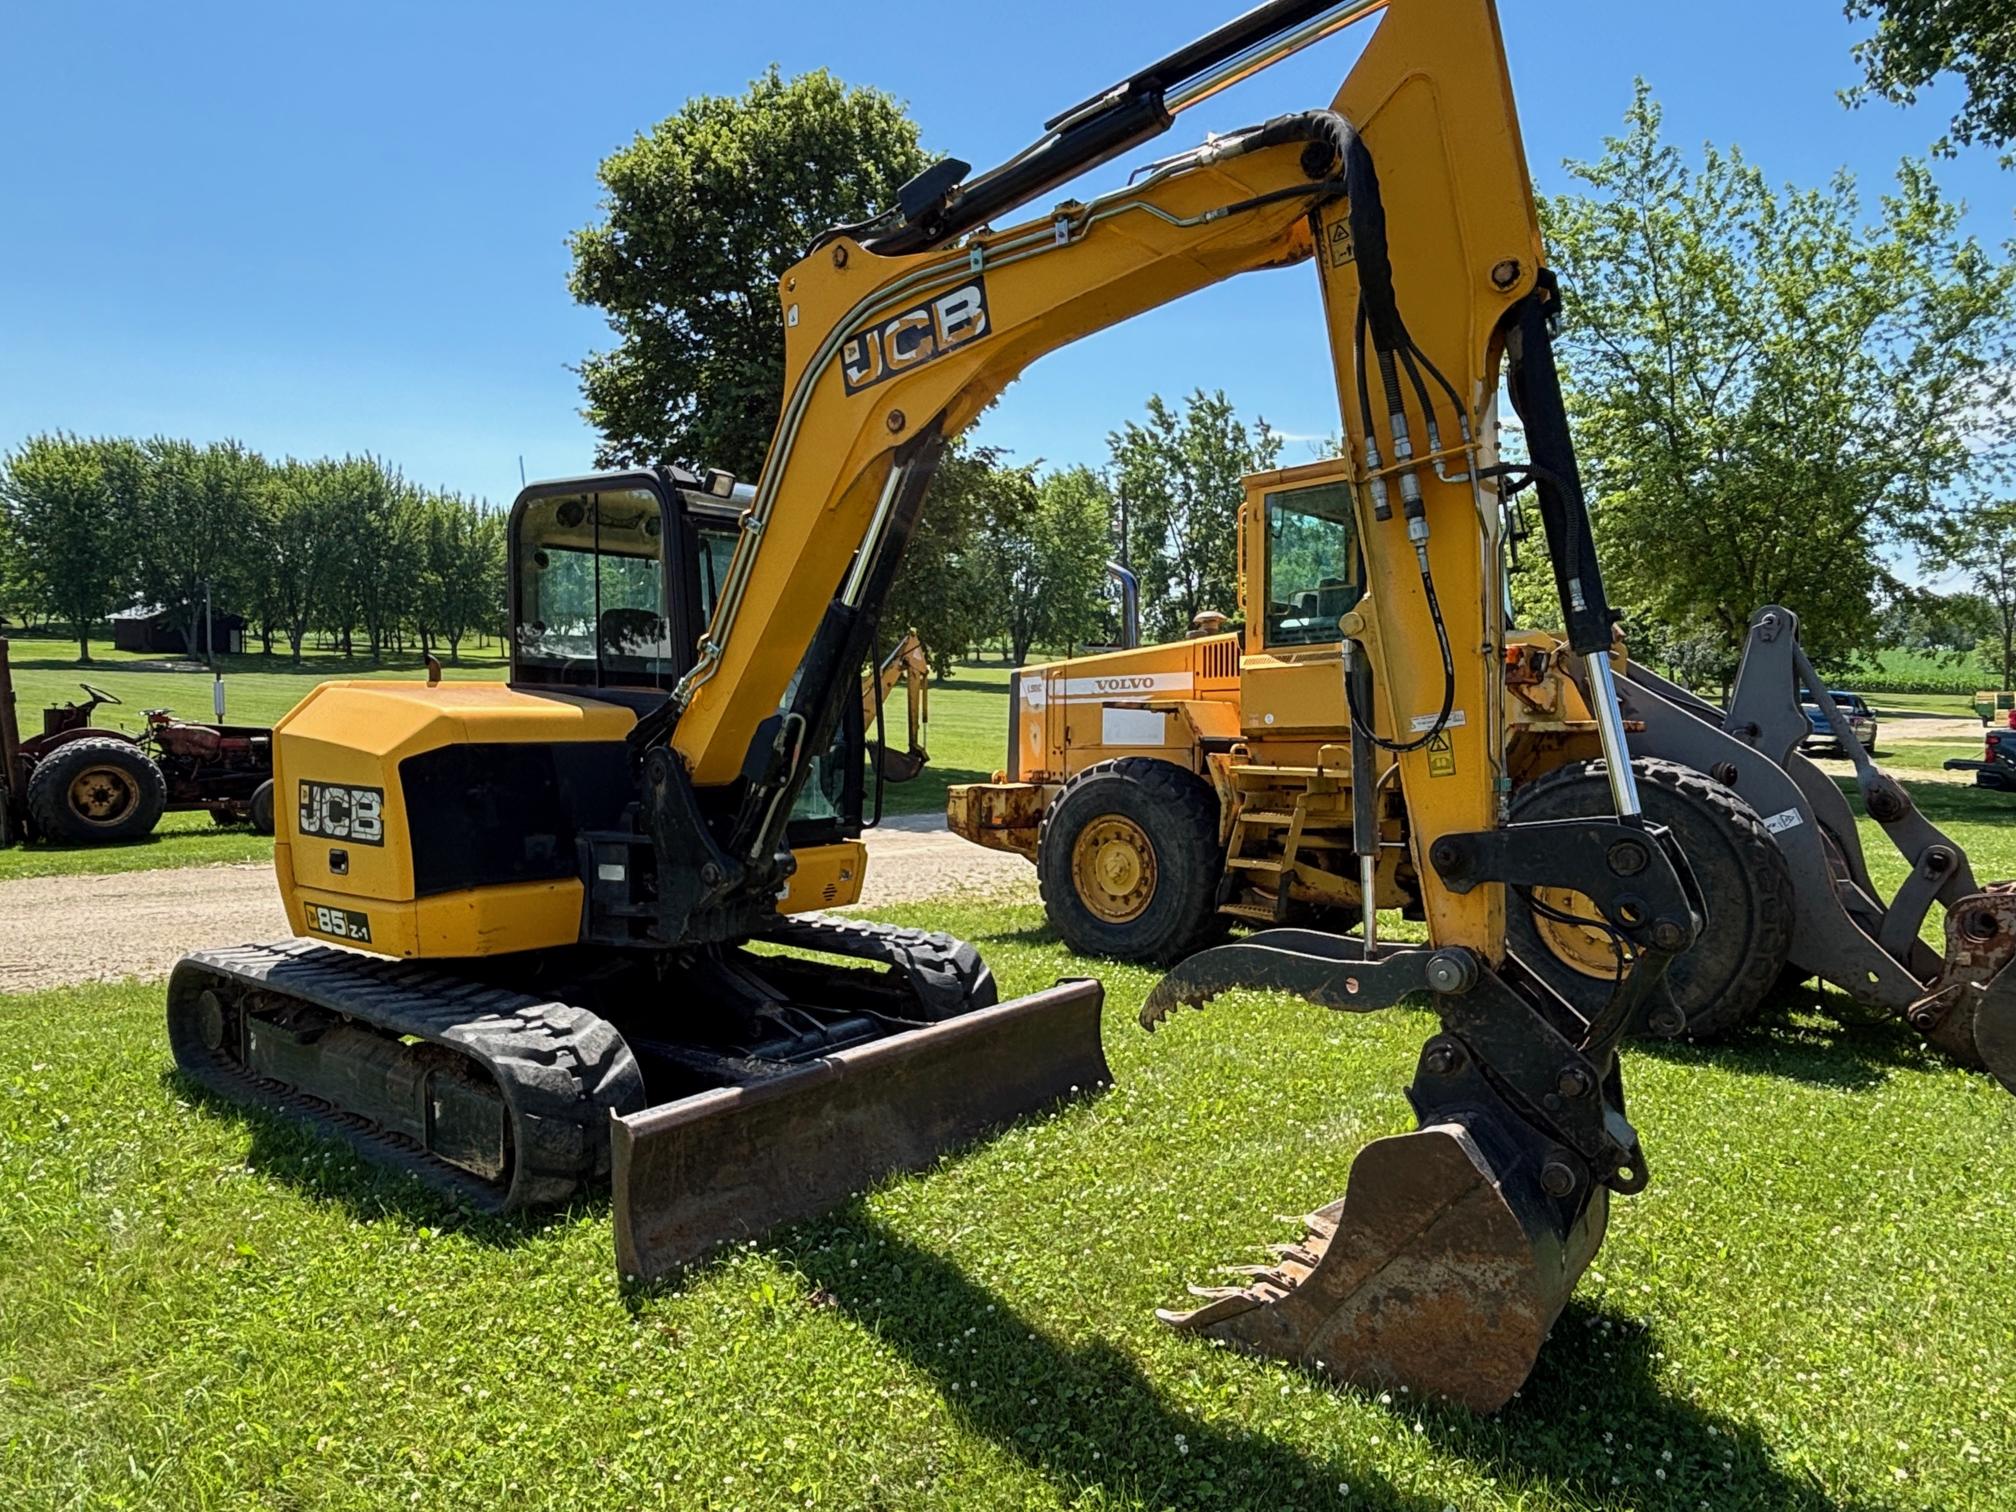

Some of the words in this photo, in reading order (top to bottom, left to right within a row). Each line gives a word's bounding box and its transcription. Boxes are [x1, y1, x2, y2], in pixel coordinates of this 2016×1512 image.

[845, 286, 986, 387] JCB
[1096, 677, 1154, 690] VOLVO
[300, 785, 382, 841] JCB
[317, 907, 347, 935] 85
